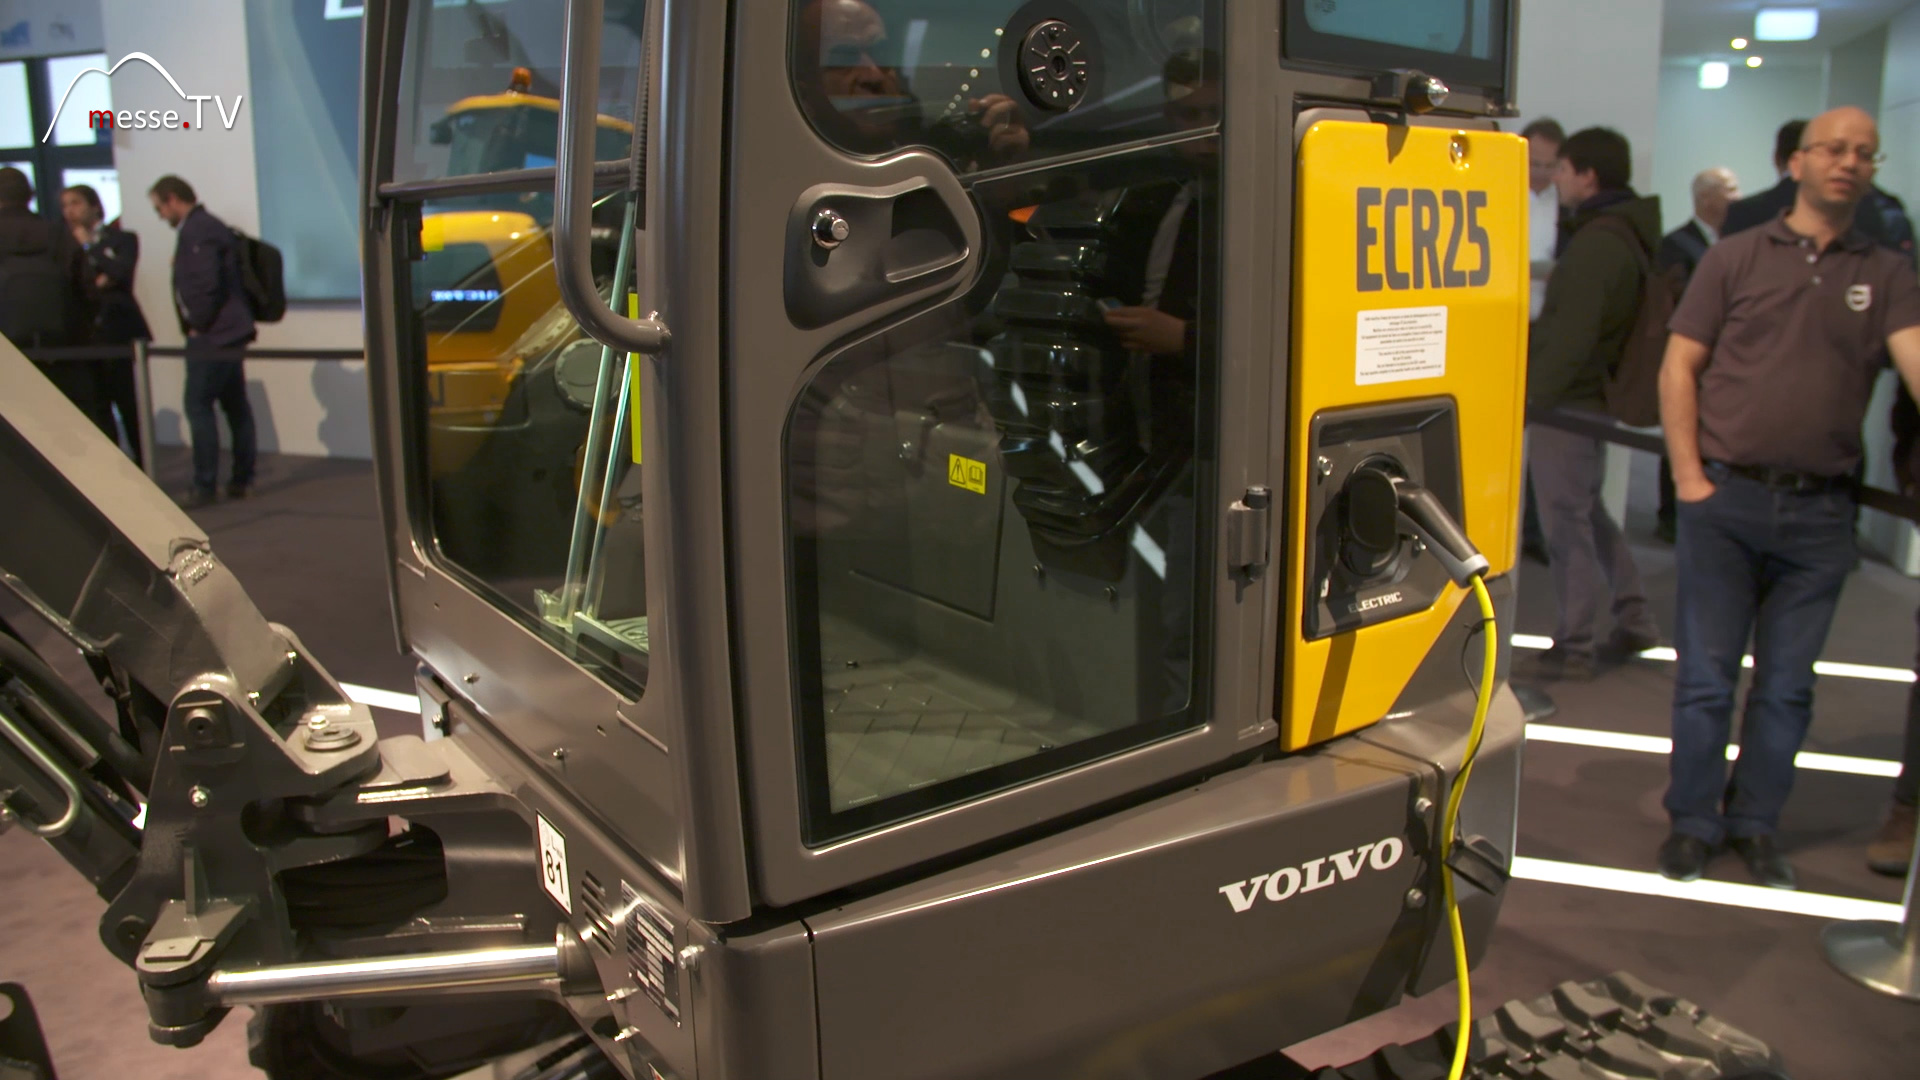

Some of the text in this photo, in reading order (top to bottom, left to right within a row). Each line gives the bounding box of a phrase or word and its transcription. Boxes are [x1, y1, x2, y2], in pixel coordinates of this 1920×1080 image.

[1357, 187, 1491, 292] ECR25
[1348, 592, 1402, 613] ELECTRIC
[545, 850, 564, 895] 81
[1219, 837, 1403, 913] VOLVO
